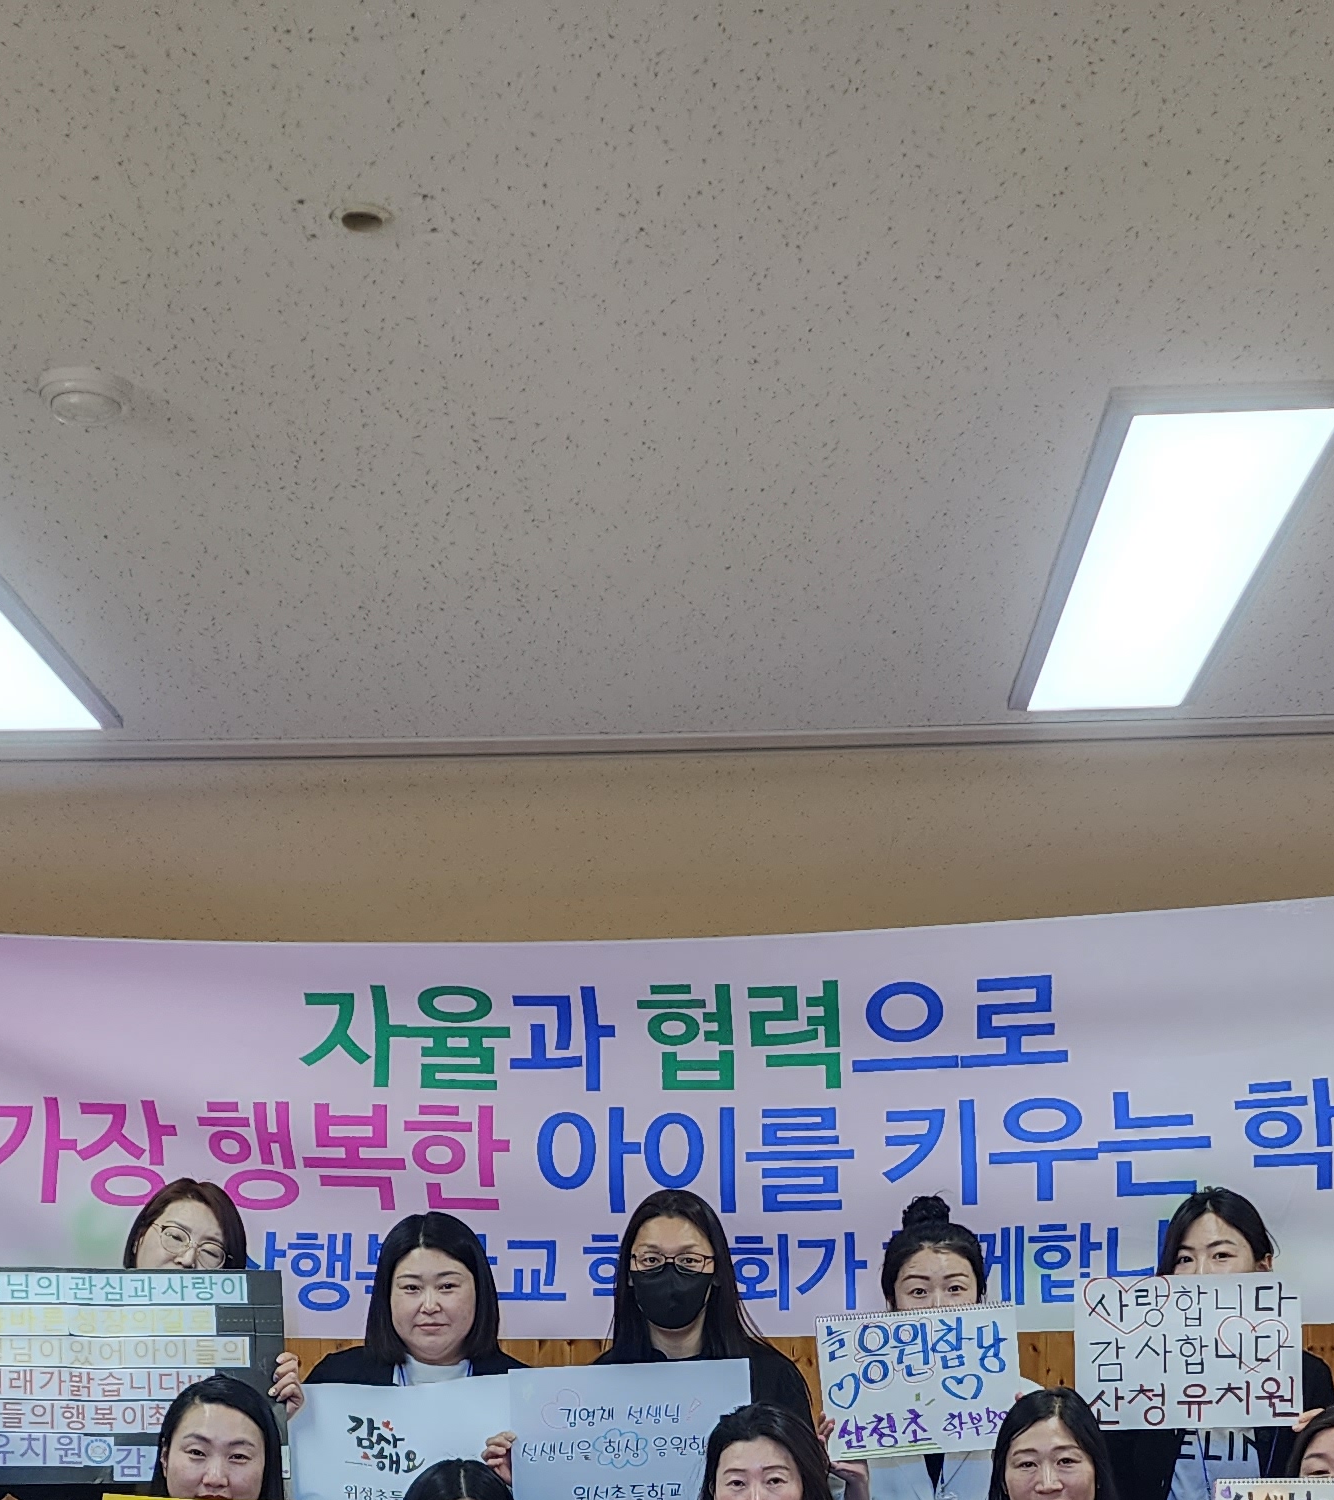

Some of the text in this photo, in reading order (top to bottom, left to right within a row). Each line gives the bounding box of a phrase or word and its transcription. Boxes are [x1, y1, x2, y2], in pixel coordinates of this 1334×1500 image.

[301, 975, 1067, 1091] 자율과 협력으로
[197, 1099, 508, 1211] 행복한
[536, 1097, 855, 1214] 아이를
[883, 1088, 1212, 1211] 키우는
[68, 1274, 153, 1302] 관심과
[161, 1274, 247, 1302] 사랑이
[1089, 1281, 1299, 1328] 사랑합니다
[134, 1337, 248, 1366] 아이들의
[1091, 1326, 1294, 1383] 감사합니다
[60, 1402, 146, 1431] 행복이
[626, 1403, 681, 1424] 선생님
[837, 1409, 933, 1450] 산청초
[347, 1414, 406, 1450] 감사
[374, 1450, 425, 1474] 해요
[521, 1434, 707, 1463] 선생님을 항상 응원합
